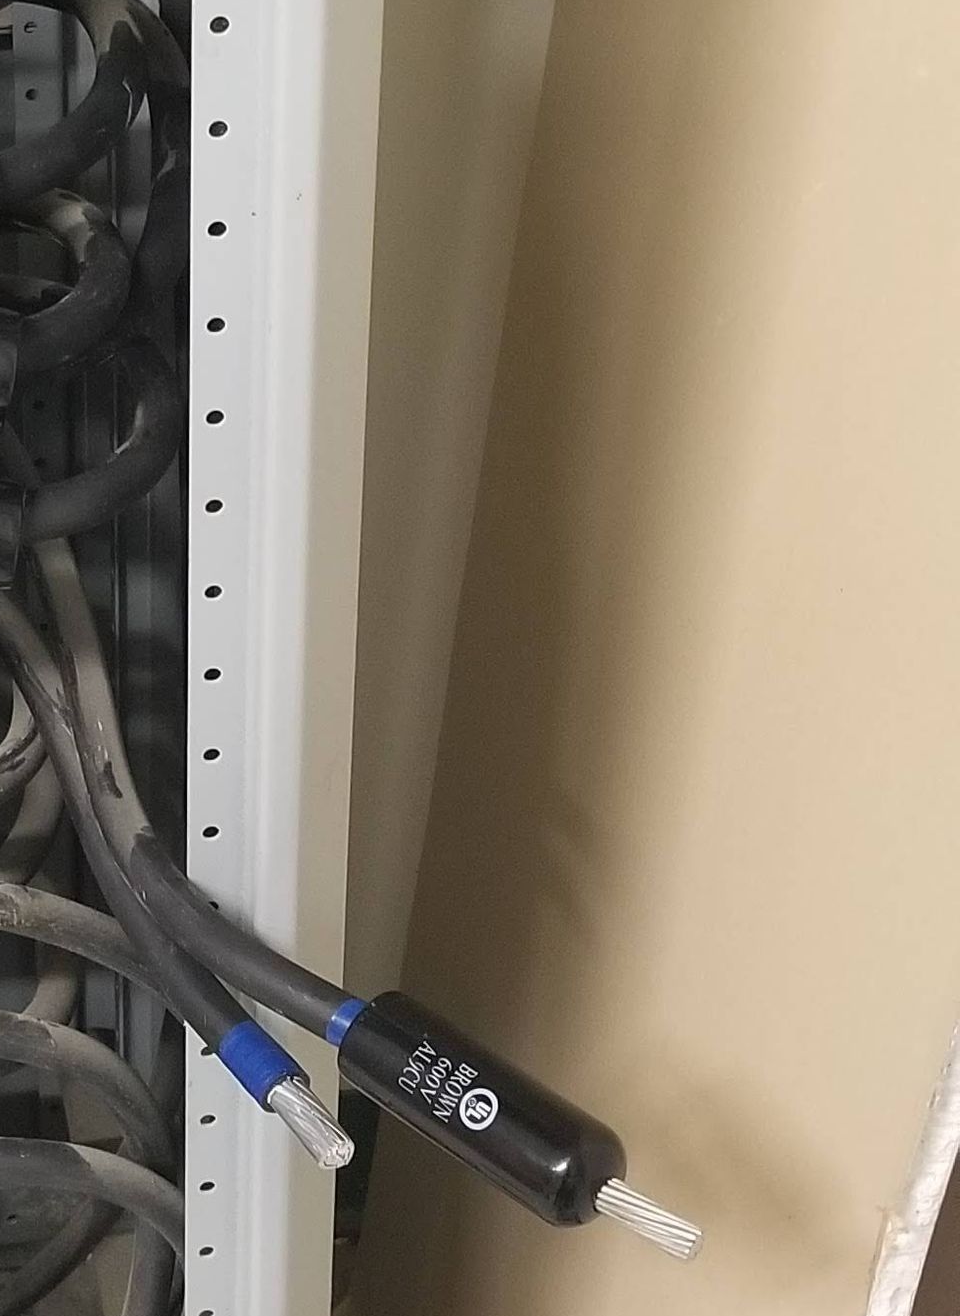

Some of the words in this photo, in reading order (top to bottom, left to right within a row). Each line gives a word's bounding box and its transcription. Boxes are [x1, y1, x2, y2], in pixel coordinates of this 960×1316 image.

[398, 1041, 437, 1095] AL9CU
[420, 1057, 452, 1105] 600V
[432, 1063, 479, 1123] BROWN
